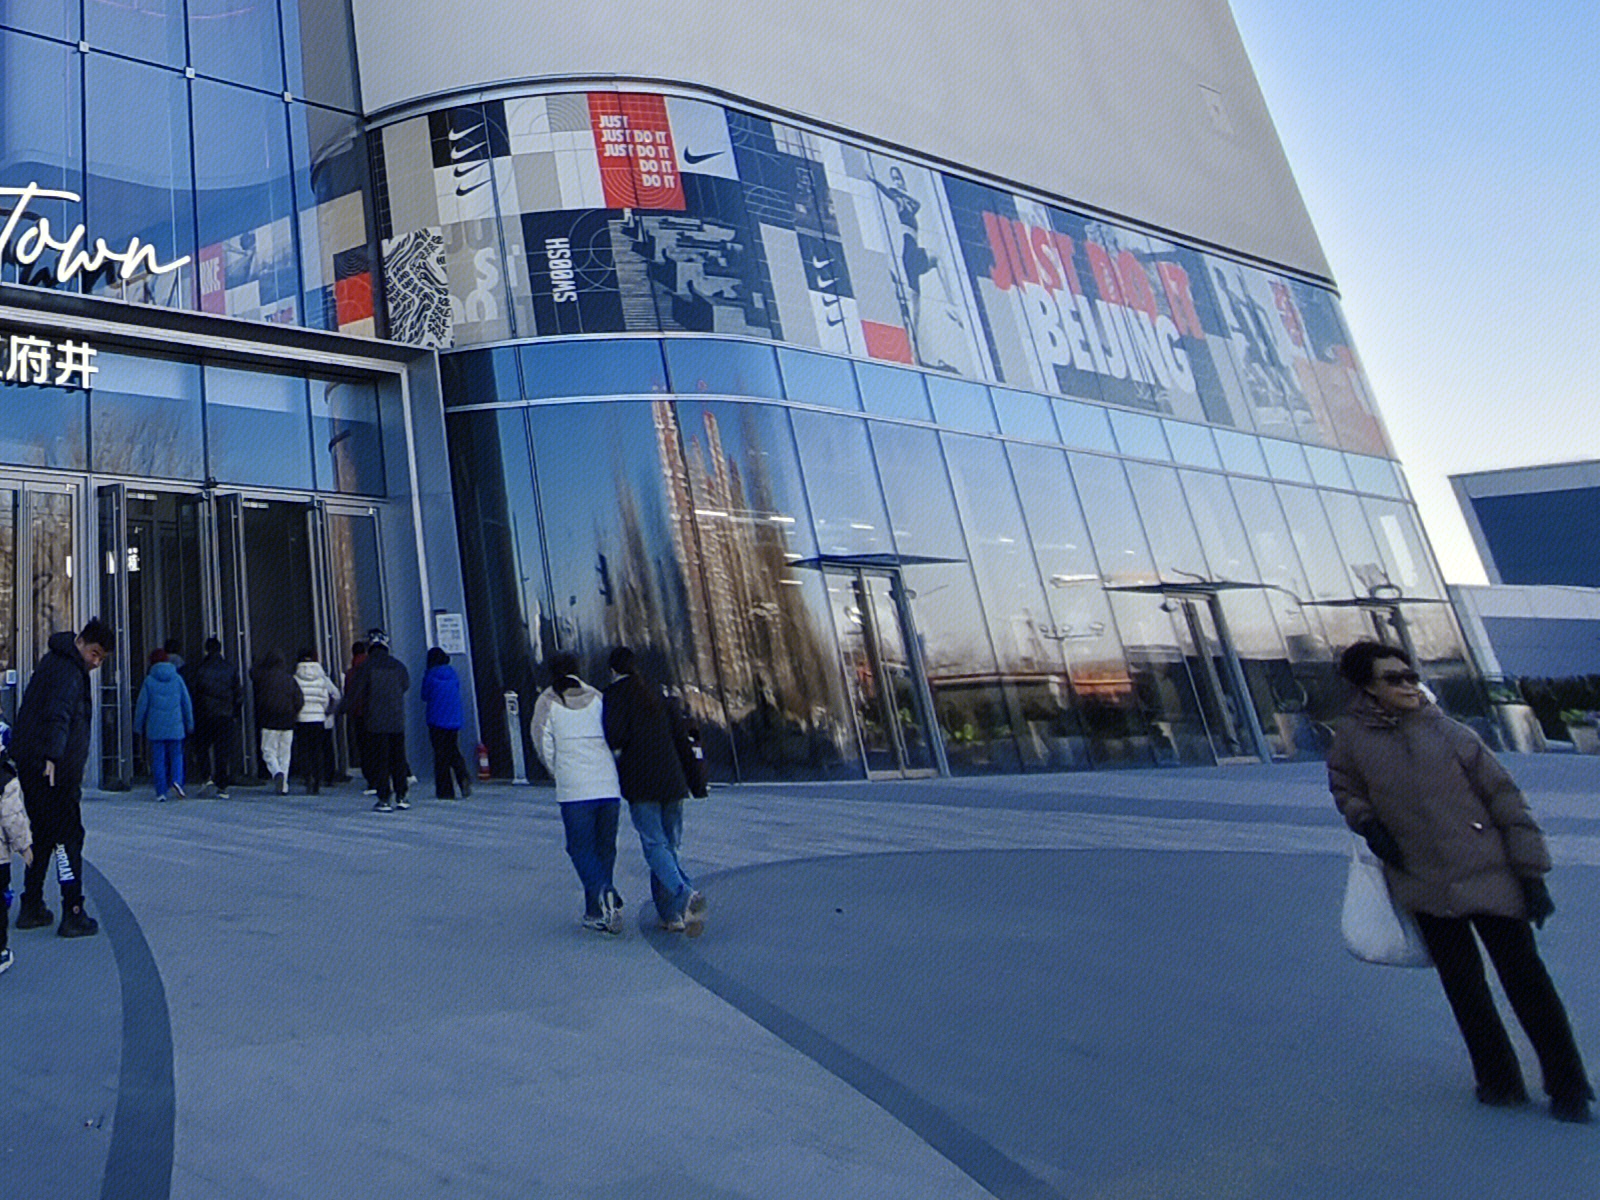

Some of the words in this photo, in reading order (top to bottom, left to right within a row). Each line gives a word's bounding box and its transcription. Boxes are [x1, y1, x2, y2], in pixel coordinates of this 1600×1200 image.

[599, 115, 628, 128] JUST
[601, 130, 631, 142] JUST
[633, 130, 653, 142] DO
[655, 132, 667, 144] IT
[603, 144, 634, 157] JUST
[636, 144, 656, 157] DO
[658, 146, 670, 158] IT
[640, 159, 658, 172] DO
[660, 160, 672, 173] IT
[642, 174, 661, 187] DO
[663, 175, 675, 188] IT
[982, 210, 1082, 296] JUST
[1085, 240, 1157, 325] DO
[1156, 260, 1206, 340] IT
[1024, 280, 1197, 395] BEIJING
